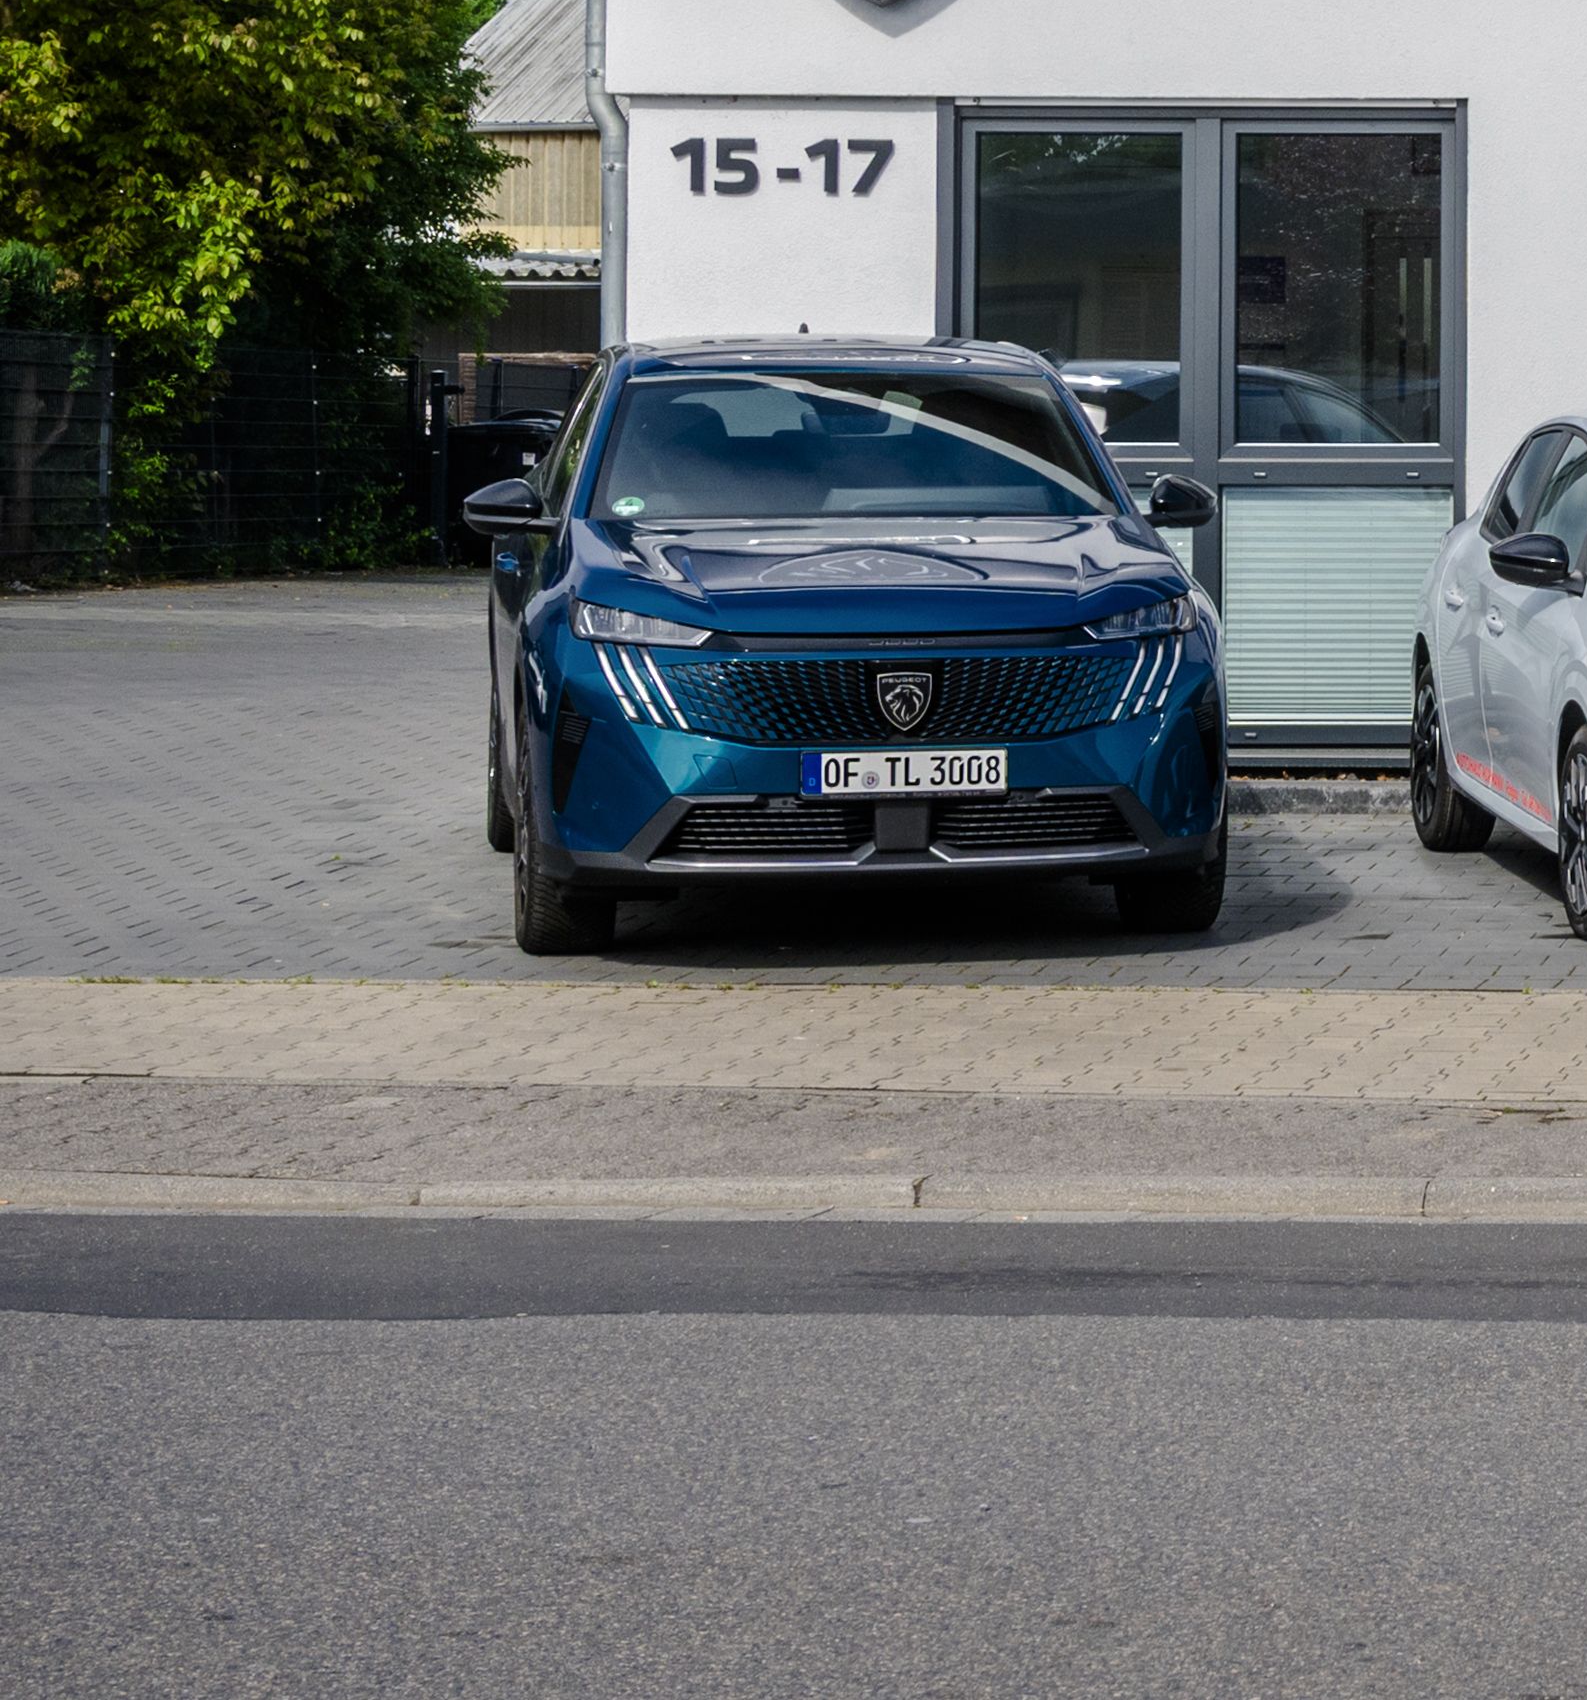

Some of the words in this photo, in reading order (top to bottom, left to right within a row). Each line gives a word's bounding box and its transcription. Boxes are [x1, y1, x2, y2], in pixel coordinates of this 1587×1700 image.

[824, 758, 861, 788] OF
[885, 757, 921, 787] TL
[930, 755, 1001, 786] 3008
